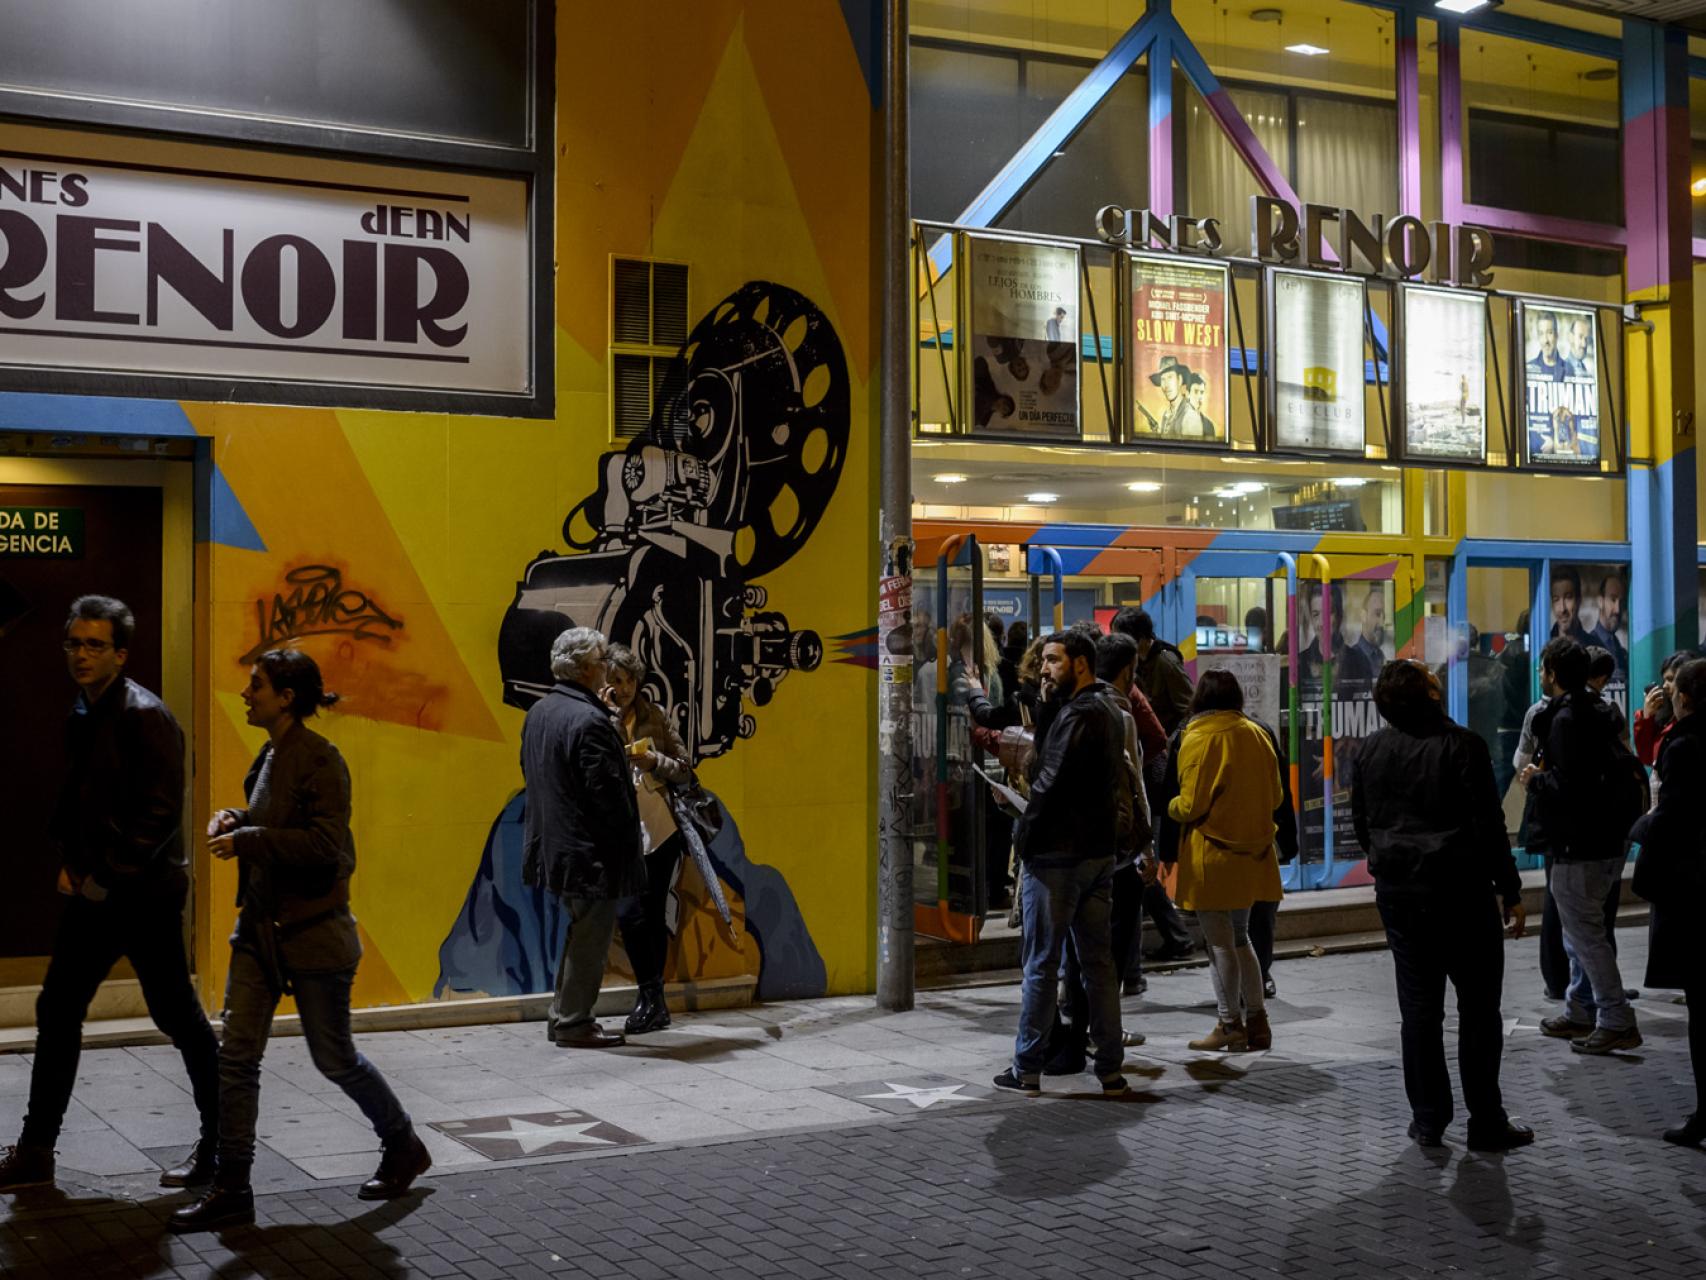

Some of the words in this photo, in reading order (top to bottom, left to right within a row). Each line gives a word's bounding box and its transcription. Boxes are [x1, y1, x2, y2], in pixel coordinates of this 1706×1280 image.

[1096, 204, 1223, 251] CINES
[1251, 195, 1495, 288] RENOIR
[1009, 289, 1062, 303] HOMBRES
[1136, 318, 1175, 343] SLOW
[1184, 322, 1221, 347] WEST
[1527, 380, 1597, 416] TRUMAN
[1313, 404, 1352, 419] CLUB
[34, 511, 59, 530] DE
